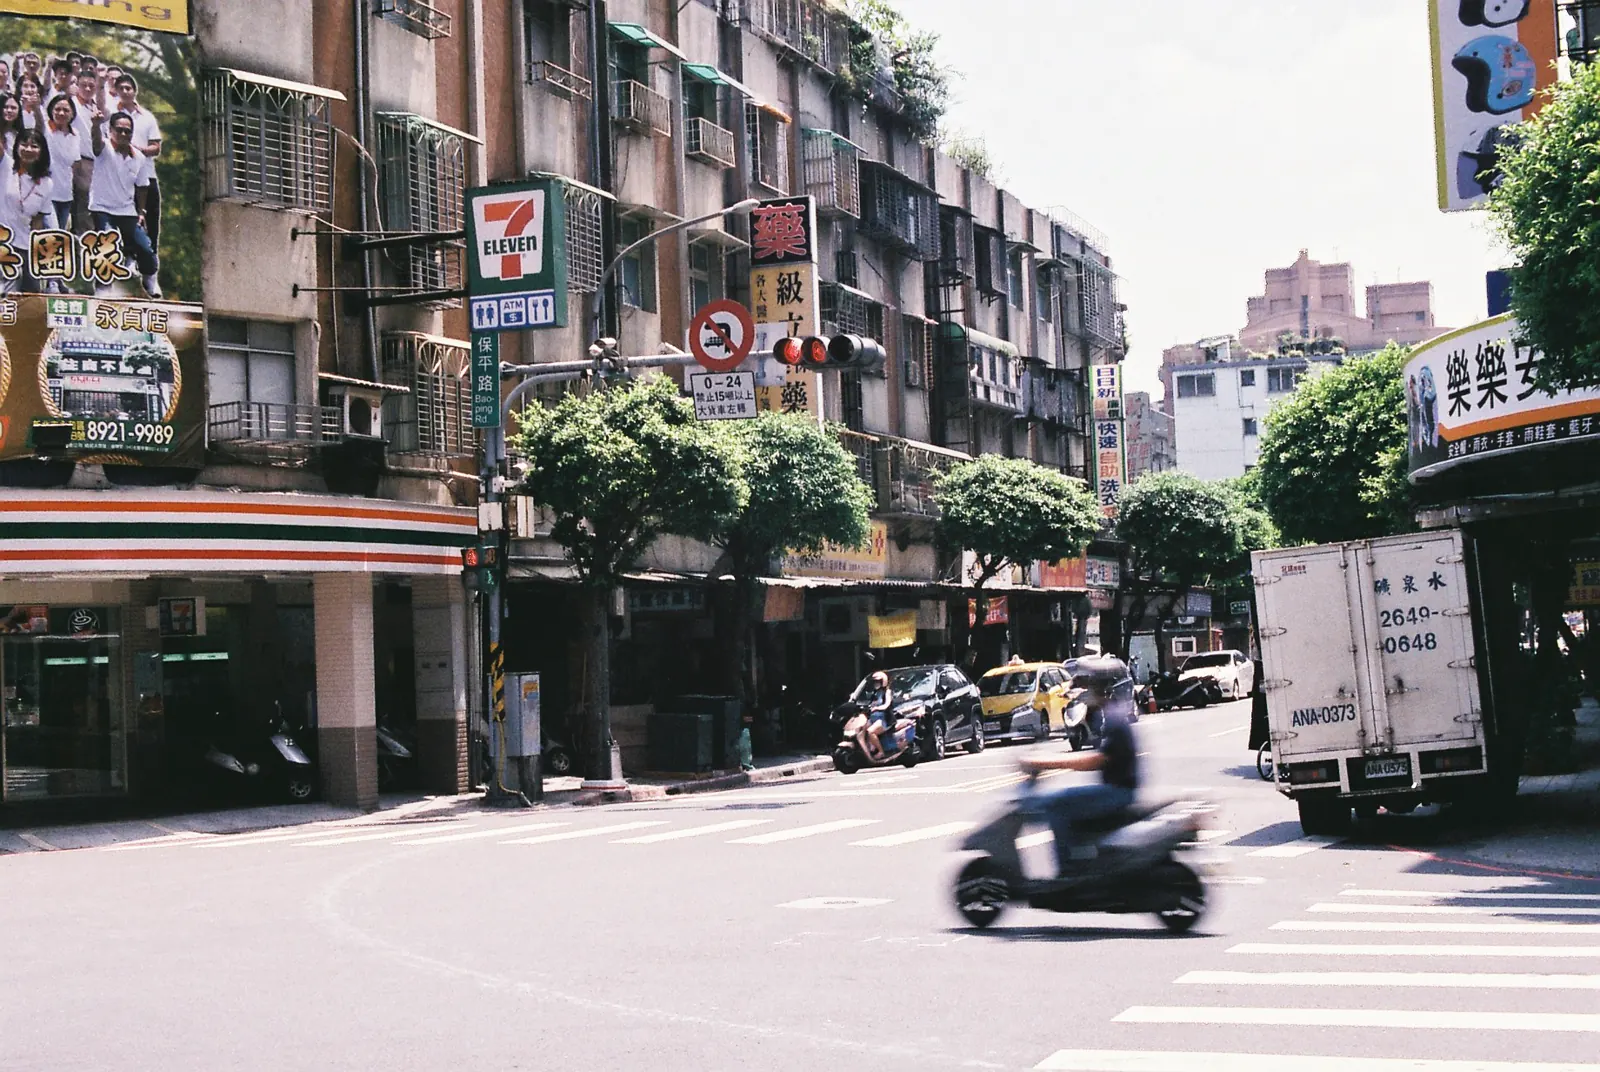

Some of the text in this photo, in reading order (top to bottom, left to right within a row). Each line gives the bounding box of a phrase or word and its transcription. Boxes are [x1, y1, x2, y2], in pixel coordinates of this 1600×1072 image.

[753, 202, 807, 259] 藥
[503, 300, 523, 311] ATM
[96, 304, 168, 333] 永貞店
[477, 336, 494, 392] 保平路
[475, 395, 495, 408] Bao-
[475, 405, 493, 416] ping
[698, 402, 747, 416] 大貨車左轉
[87, 420, 174, 445] 8921-9989
[1374, 571, 1446, 596] 礦泉水
[1380, 606, 1439, 628] 2649-
[1384, 632, 1437, 655] 0648
[1292, 704, 1356, 728] ANA-0373
